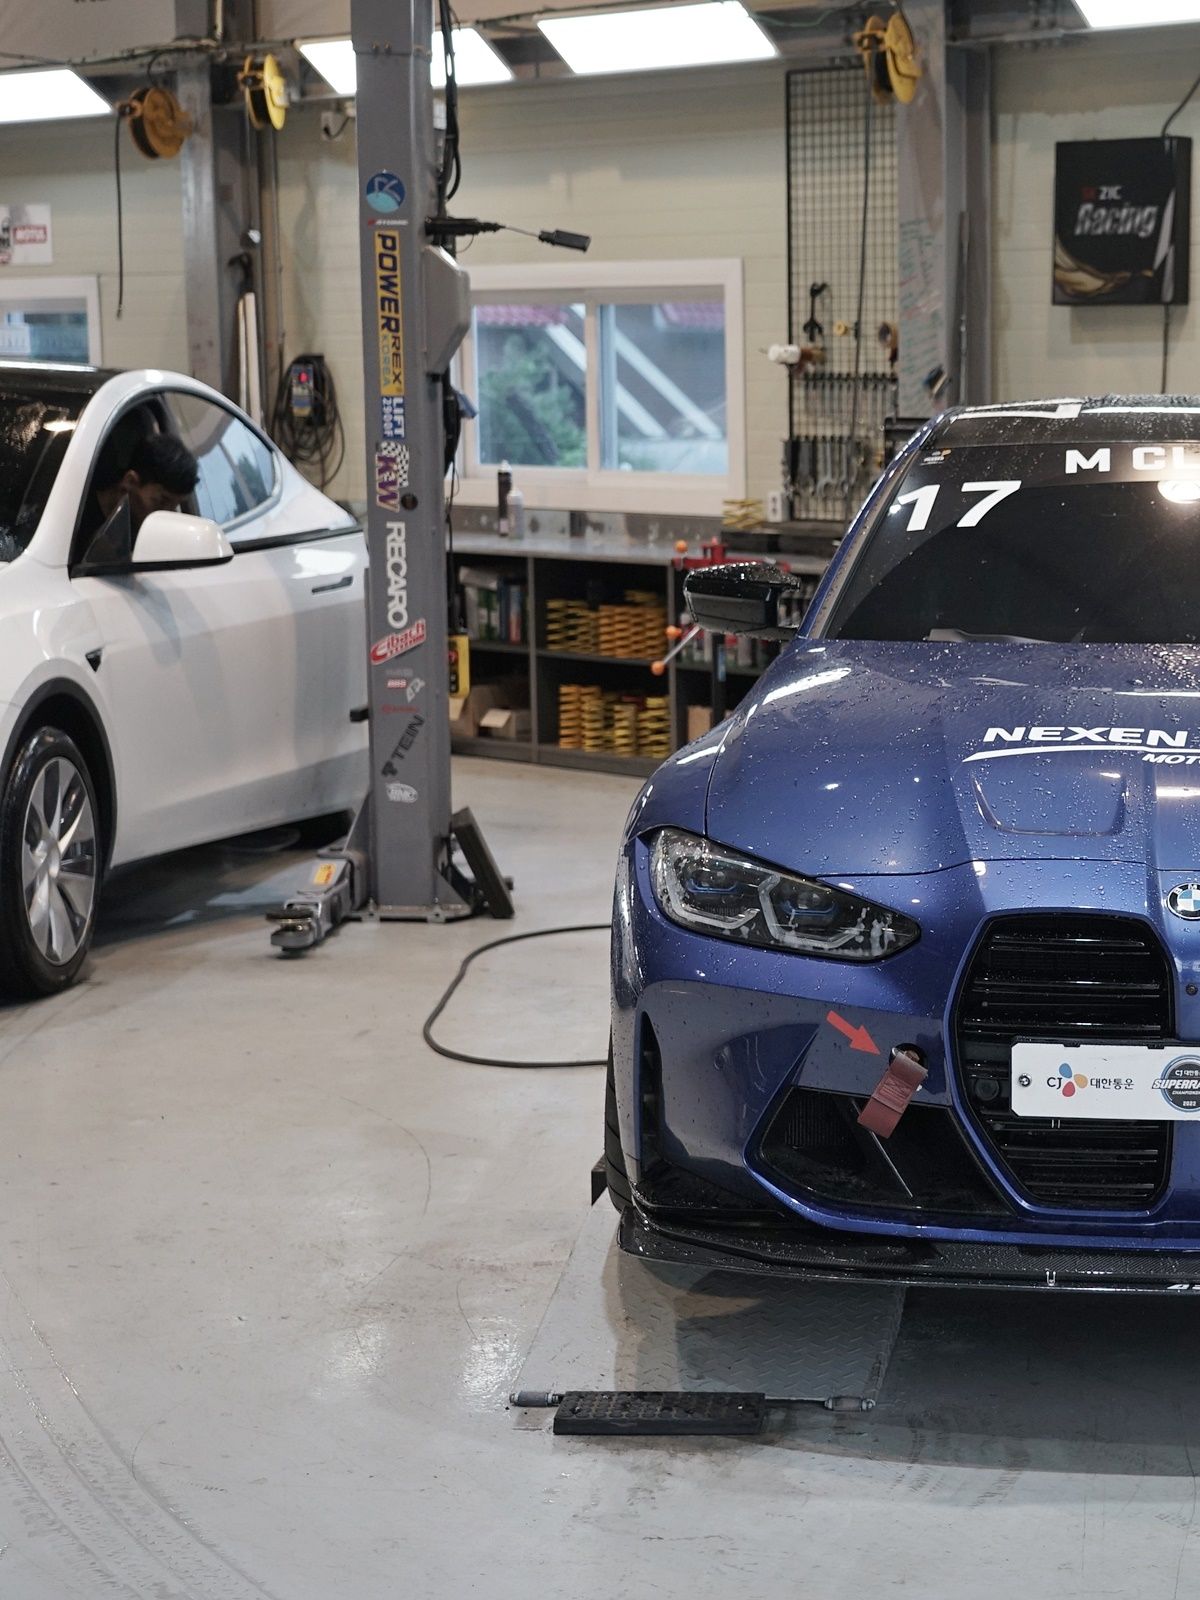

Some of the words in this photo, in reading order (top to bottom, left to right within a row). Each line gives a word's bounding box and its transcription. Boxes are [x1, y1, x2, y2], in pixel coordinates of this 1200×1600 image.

[1065, 448, 1111, 474] M
[897, 480, 1022, 532] 17
[386, 521, 408, 629] RECARO
[391, 714, 425, 760] TEIN
[983, 727, 1188, 747] NEXEN
[1046, 1077, 1063, 1090] CJ
[1090, 1077, 1135, 1090] 대한통운
